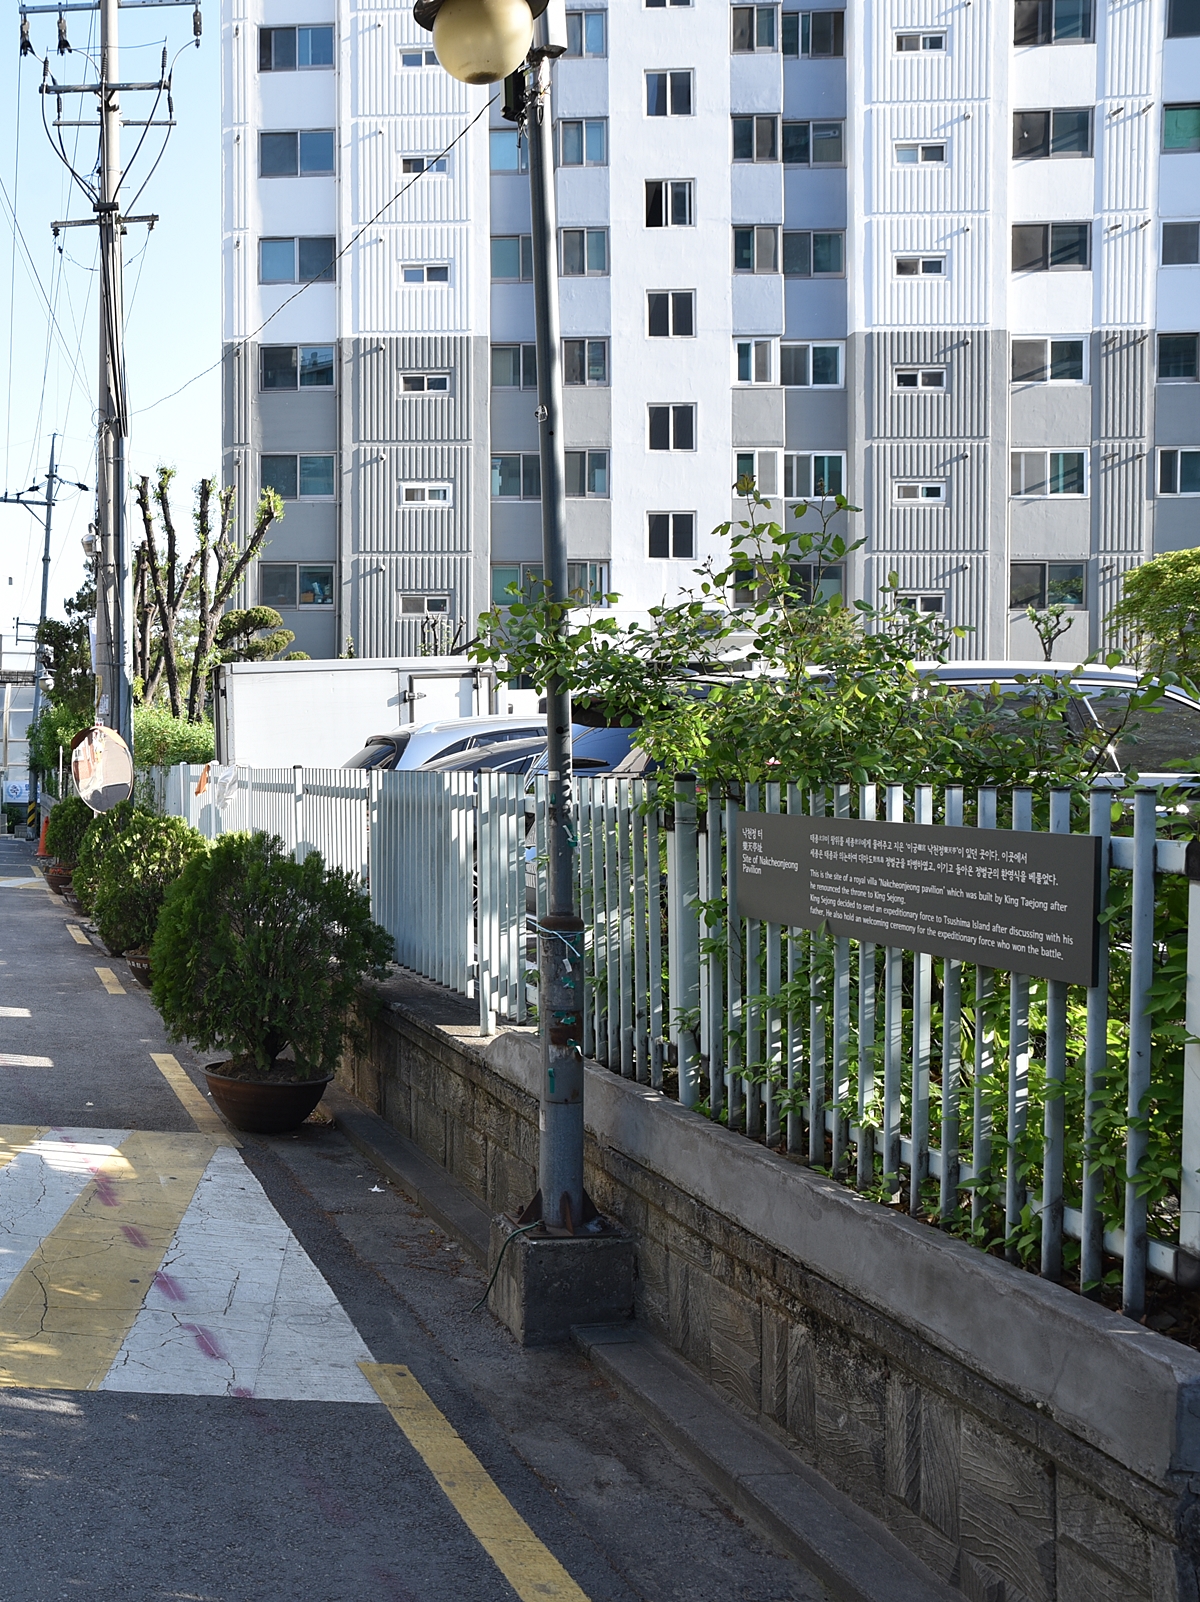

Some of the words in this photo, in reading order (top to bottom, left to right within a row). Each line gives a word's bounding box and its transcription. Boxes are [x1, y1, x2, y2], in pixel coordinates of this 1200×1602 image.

[742, 827, 757, 840] 낙천정
[757, 828, 763, 840] 터
[742, 853, 752, 864] Site
[752, 855, 758, 864] of
[759, 856, 799, 872] Nakcheonjeong
[830, 836, 844, 847] 왕위를
[872, 839, 893, 850] 물려주고
[894, 841, 905, 852] 지은
[965, 847, 977, 860] 있던
[979, 849, 1000, 861] 곳이다.
[1001, 850, 1027, 864] 이곳에서
[742, 864, 762, 875] Pavilion
[810, 848, 823, 859] 세종은
[824, 850, 838, 860] 태종과
[839, 851, 858, 862] 의논하여
[885, 856, 906, 869] 정벌군을
[906, 858, 936, 872] 파병하였고,
[937, 862, 954, 873] 이기고
[955, 864, 974, 877] 돌아온
[975, 866, 999, 879] 정벌군의
[1000, 868, 1027, 883] 환영식을
[1028, 871, 1058, 886] 베풀었다.
[810, 869, 819, 878] This
[820, 870, 824, 879] is
[825, 871, 833, 880] the
[834, 873, 842, 881] site
[843, 874, 849, 882] of
[854, 876, 866, 885] royal
[867, 877, 878, 886] villa
[946, 887, 964, 898] which
[965, 892, 977, 900] was
[978, 891, 993, 902] built
[994, 893, 1003, 905] by
[1004, 894, 1019, 907] King
[1020, 896, 1048, 912] Taejong
[1050, 901, 1068, 912] after
[810, 881, 816, 890] he
[816, 884, 841, 893] renounced
[841, 886, 850, 895] the
[850, 888, 867, 898] throne
[868, 891, 874, 899] to
[874, 891, 886, 902] King
[887, 893, 906, 905] Sejong.
[810, 894, 820, 904] King
[821, 895, 836, 907] Sejong
[837, 898, 856, 909] decided
[856, 902, 862, 910] to
[863, 904, 875, 912] send
[883, 906, 918, 921] expeditionary
[919, 911, 935, 922] force
[936, 915, 942, 923] to
[943, 915, 971, 928] Tsushima
[972, 919, 991, 931] Island
[992, 923, 1008, 934] after
[1009, 926, 1044, 942] discussing
[1046, 932, 1061, 943] with
[1063, 934, 1074, 945] his
[810, 906, 825, 917] father.
[825, 909, 833, 917] He
[833, 911, 843, 919] also
[844, 912, 855, 922] hold
[863, 917, 889, 930] welcoming
[890, 922, 916, 934] ceremony
[917, 925, 926, 934] for
[927, 927, 937, 937] the
[937, 930, 978, 945] expeditionary
[978, 936, 996, 947] force
[997, 940, 1011, 950] who
[1012, 944, 1026, 953] won
[1028, 945, 1039, 955] the
[1041, 946, 1064, 961] battle.
